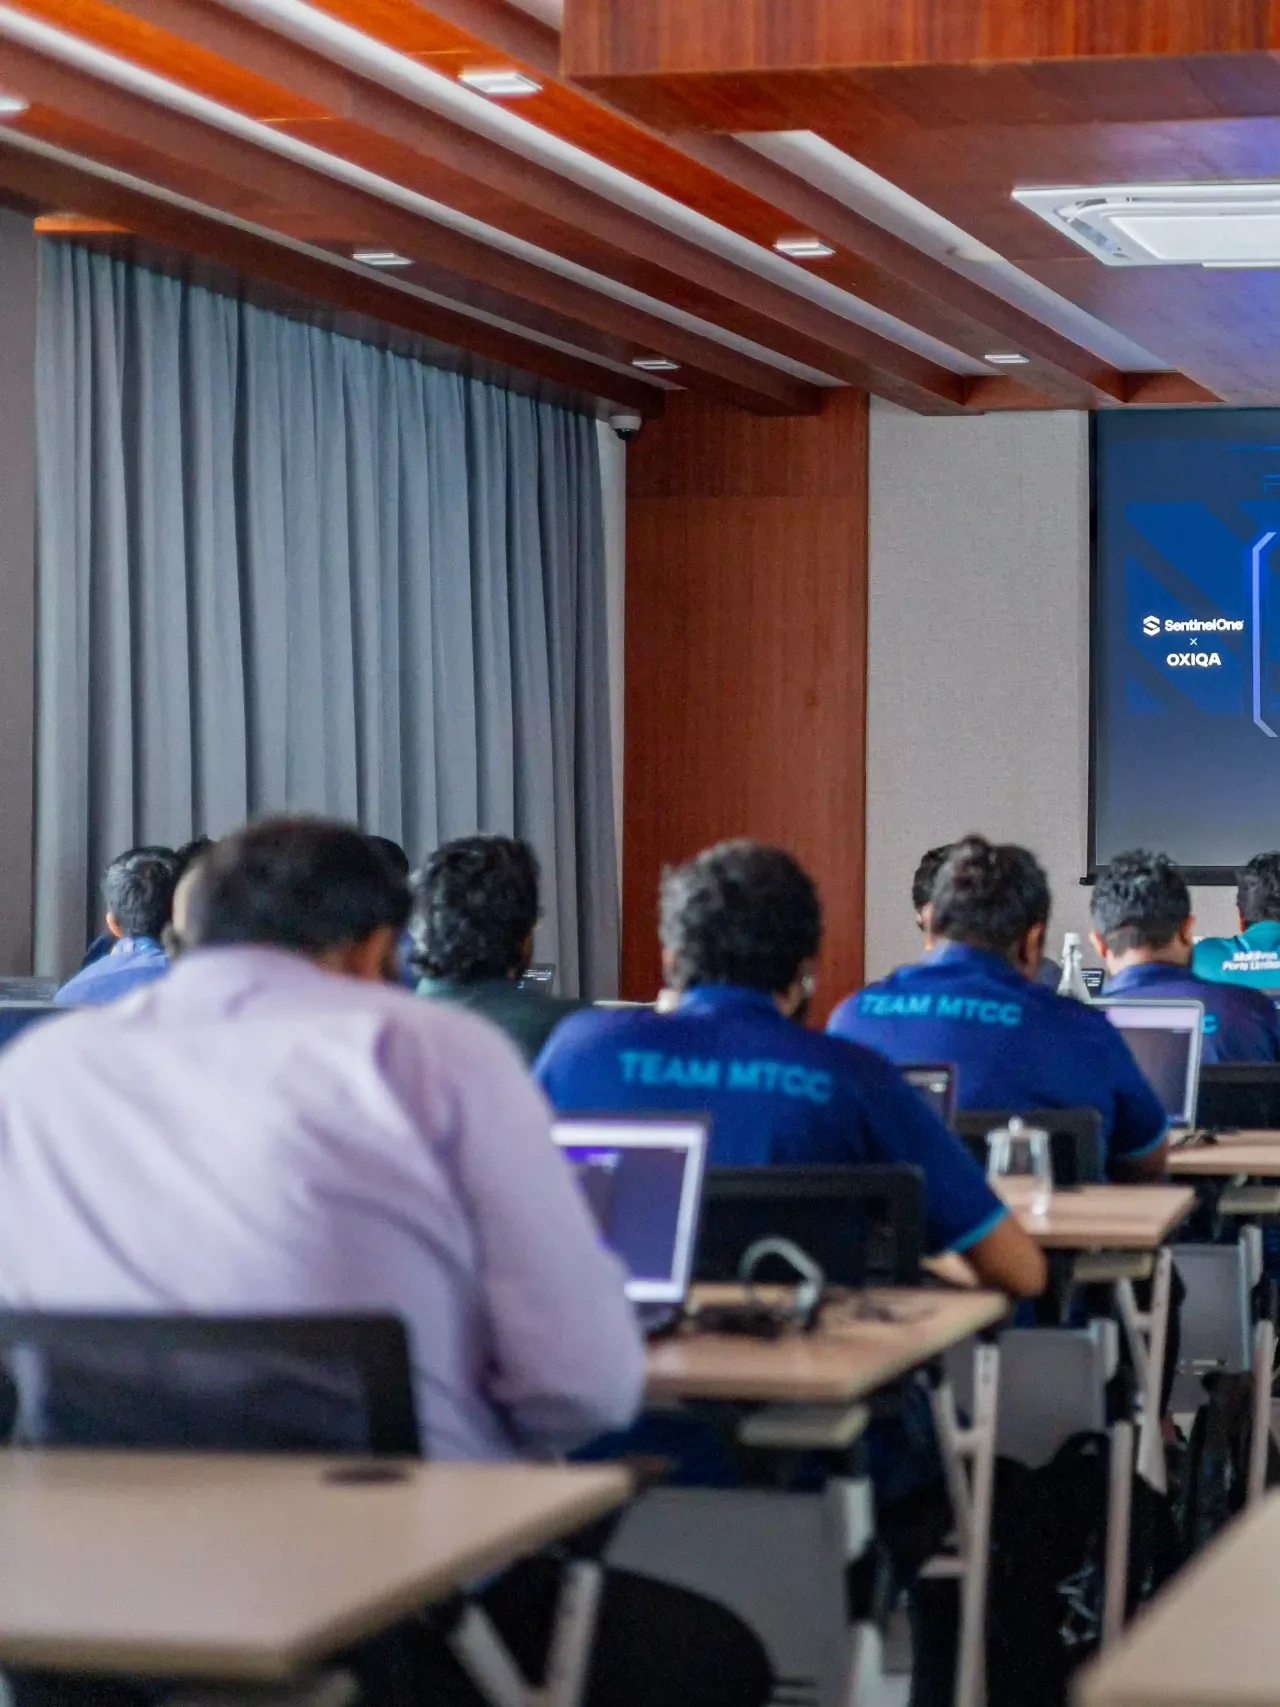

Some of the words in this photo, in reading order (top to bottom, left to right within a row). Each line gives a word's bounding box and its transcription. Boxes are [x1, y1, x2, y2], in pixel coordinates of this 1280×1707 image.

[1164, 618, 1244, 632] SentinelOne
[1166, 652, 1221, 667] OXIQA
[859, 994, 931, 1017] TEAM
[936, 1001, 1022, 1027] MTCC
[617, 1051, 718, 1089] TEAM
[725, 1058, 832, 1102] MTCC
